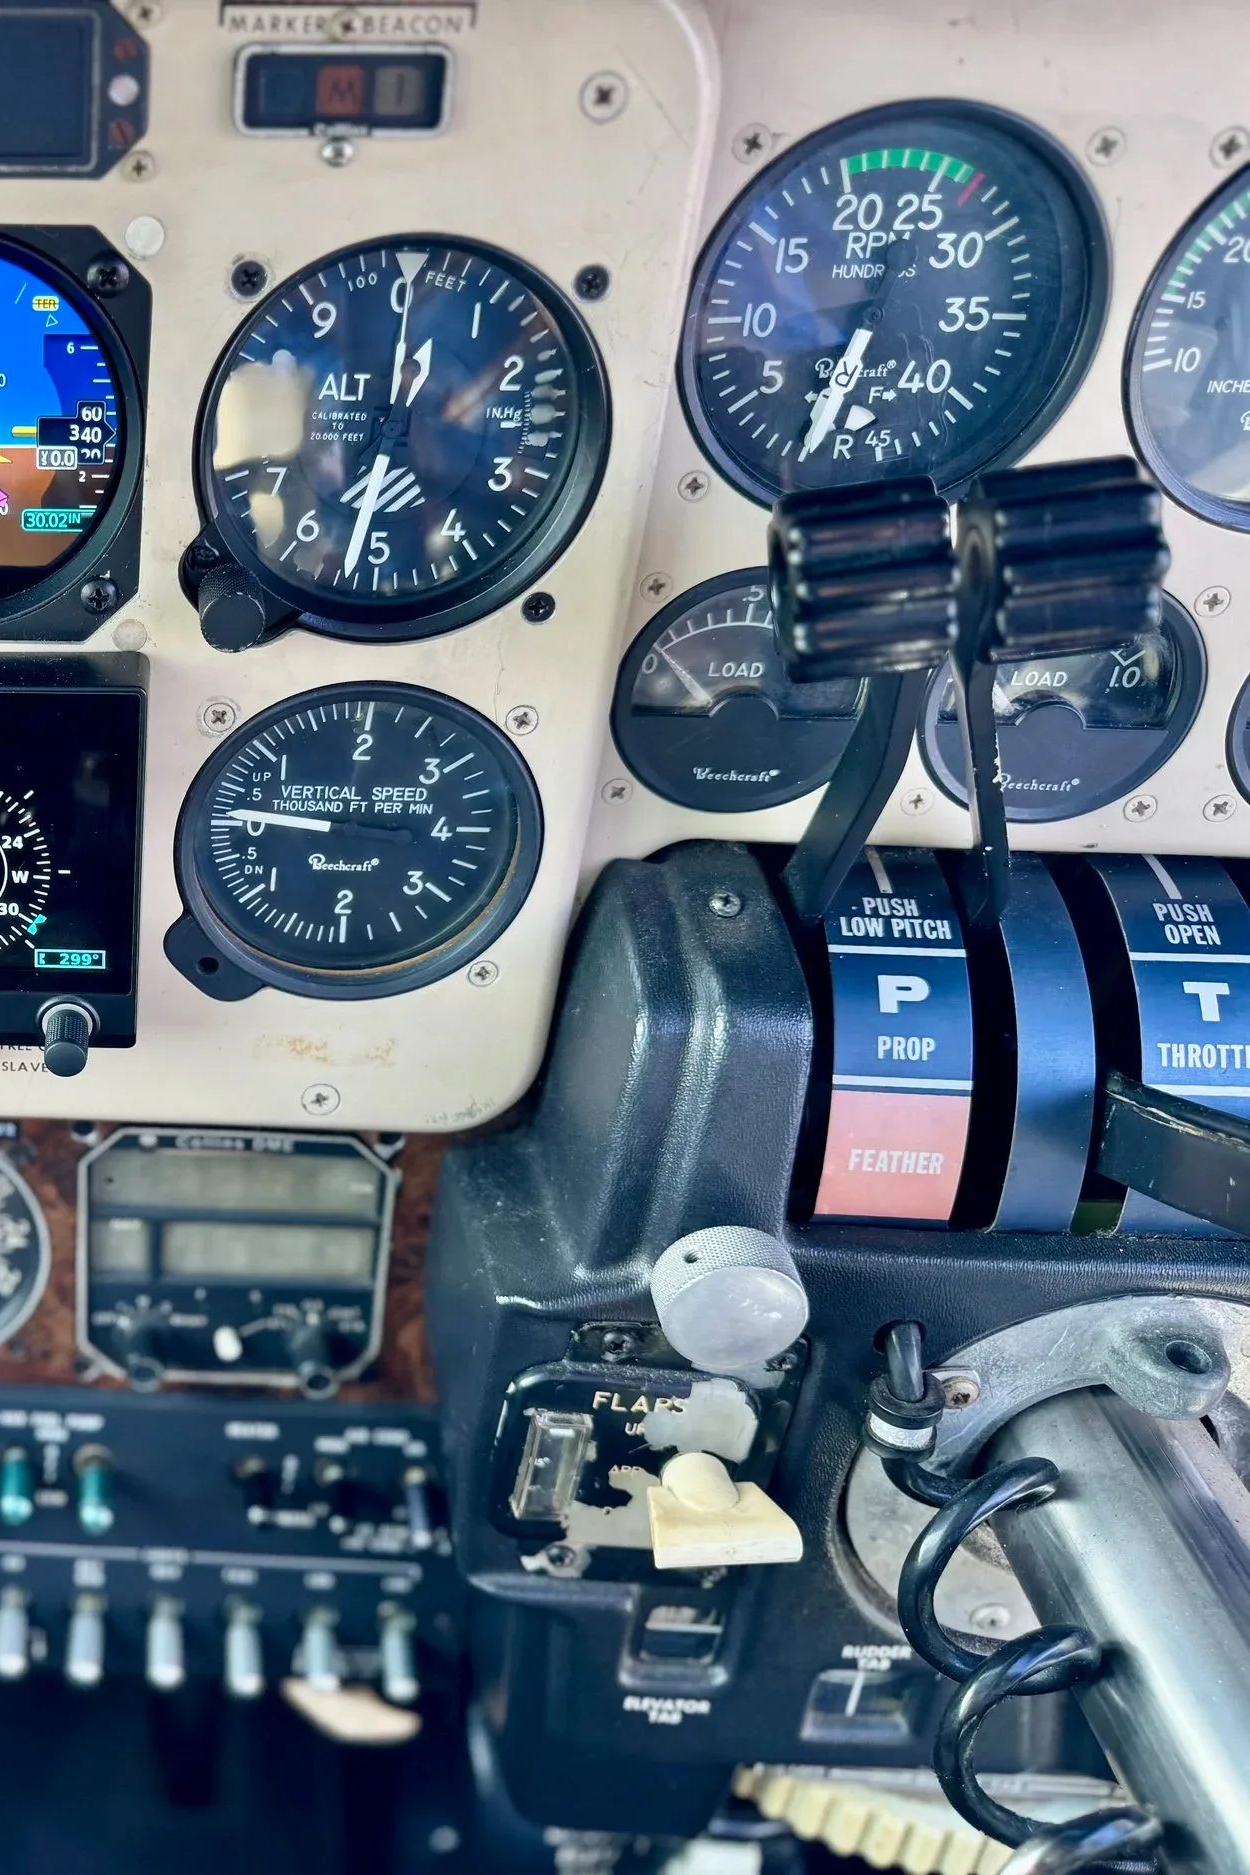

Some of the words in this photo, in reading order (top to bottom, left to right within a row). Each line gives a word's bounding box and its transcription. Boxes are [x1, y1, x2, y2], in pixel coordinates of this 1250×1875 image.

[228, 16, 327, 34] MARKER
[364, 17, 463, 35] BEACON
[832, 194, 882, 231] 20
[893, 194, 942, 231] 25
[775, 237, 809, 274] 15
[929, 232, 984, 269] 30
[424, 271, 466, 292] FEET
[312, 302, 337, 339] 9
[741, 302, 776, 337] 10
[939, 296, 990, 332] 35
[1173, 345, 1202, 373] 10
[499, 355, 524, 392] 2
[898, 361, 951, 394] 40
[318, 373, 371, 401] ALT
[311, 410, 368, 422] CALIBRATED
[342, 431, 364, 442] FEET
[865, 429, 891, 448] 45
[50, 450, 75, 467] 0.0
[487, 456, 511, 492] 3
[296, 509, 320, 542] 6
[441, 507, 466, 542] 4
[367, 531, 391, 565] 5
[708, 659, 764, 679] LOAD
[1010, 668, 1069, 689] LOAD
[352, 733, 374, 761] 2
[252, 771, 272, 782] UP
[418, 758, 440, 785] 3
[280, 785, 362, 801] VERTICAL
[371, 786, 428, 802] SPEED
[271, 800, 343, 813] THOUSAND
[349, 800, 367, 814] FT
[374, 801, 403, 815] PER
[409, 802, 433, 816] MIN
[430, 816, 452, 842] 4
[1, 835, 24, 850] 24
[11, 870, 29, 884] W
[244, 864, 264, 876] DN
[402, 870, 424, 896] 3
[334, 889, 354, 914] 2
[861, 897, 919, 918] PUSH
[1152, 902, 1215, 923] PUSH
[840, 917, 888, 939] LOW
[891, 920, 952, 941] PITCH
[1163, 924, 1222, 946] OPEN
[877, 974, 931, 1014] P
[1182, 980, 1230, 1022] T
[876, 1035, 936, 1062] PROP
[847, 1149, 944, 1175] FEATHER
[622, 1695, 712, 1715] ELEVATOR
